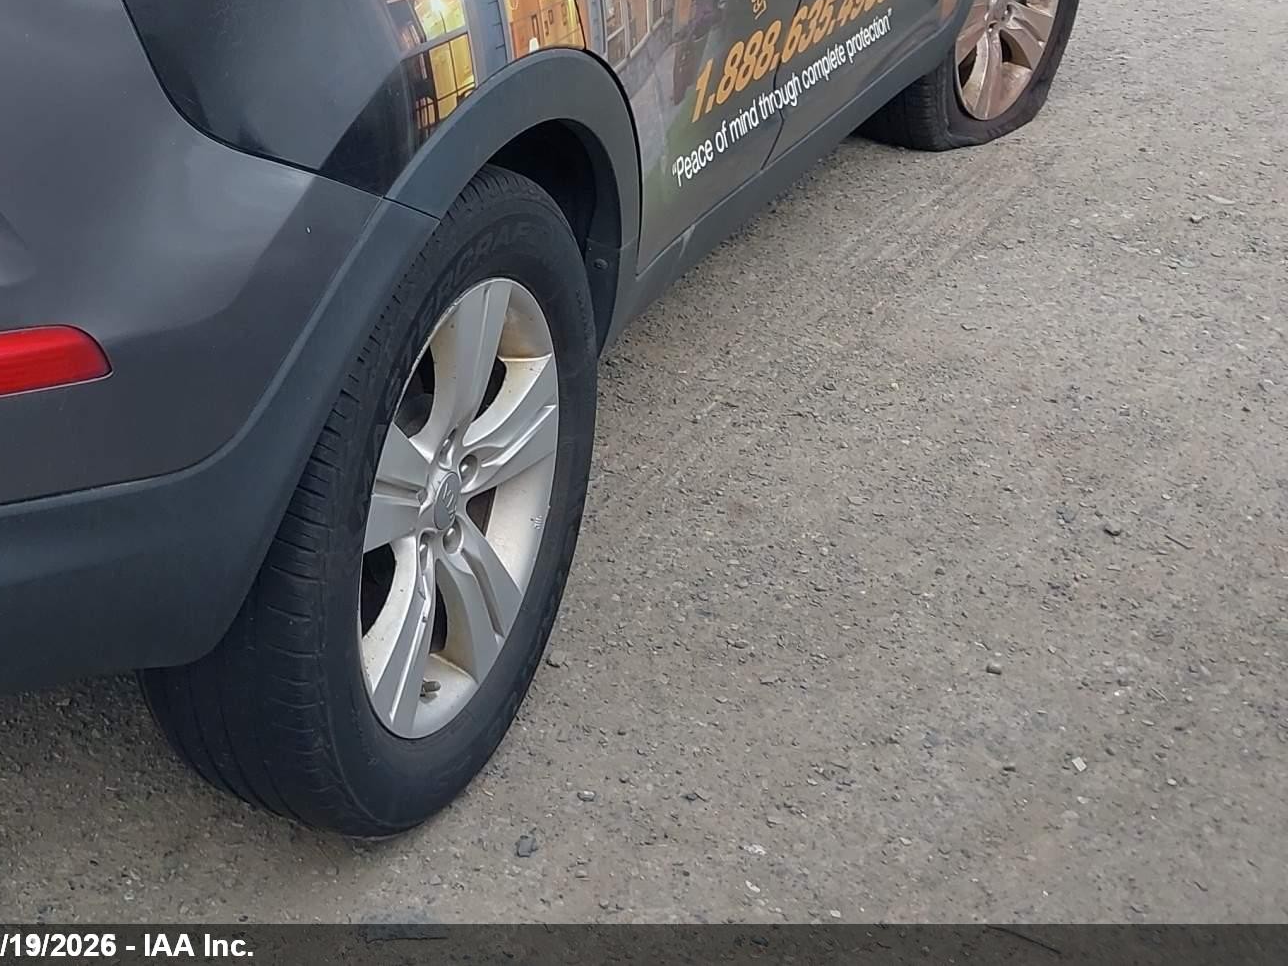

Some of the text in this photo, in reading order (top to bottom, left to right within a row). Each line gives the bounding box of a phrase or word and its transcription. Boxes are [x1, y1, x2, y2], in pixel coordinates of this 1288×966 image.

[714, 118, 730, 154] of
[728, 96, 760, 146] mind
[758, 70, 804, 120] through
[801, 43, 847, 90] complete
